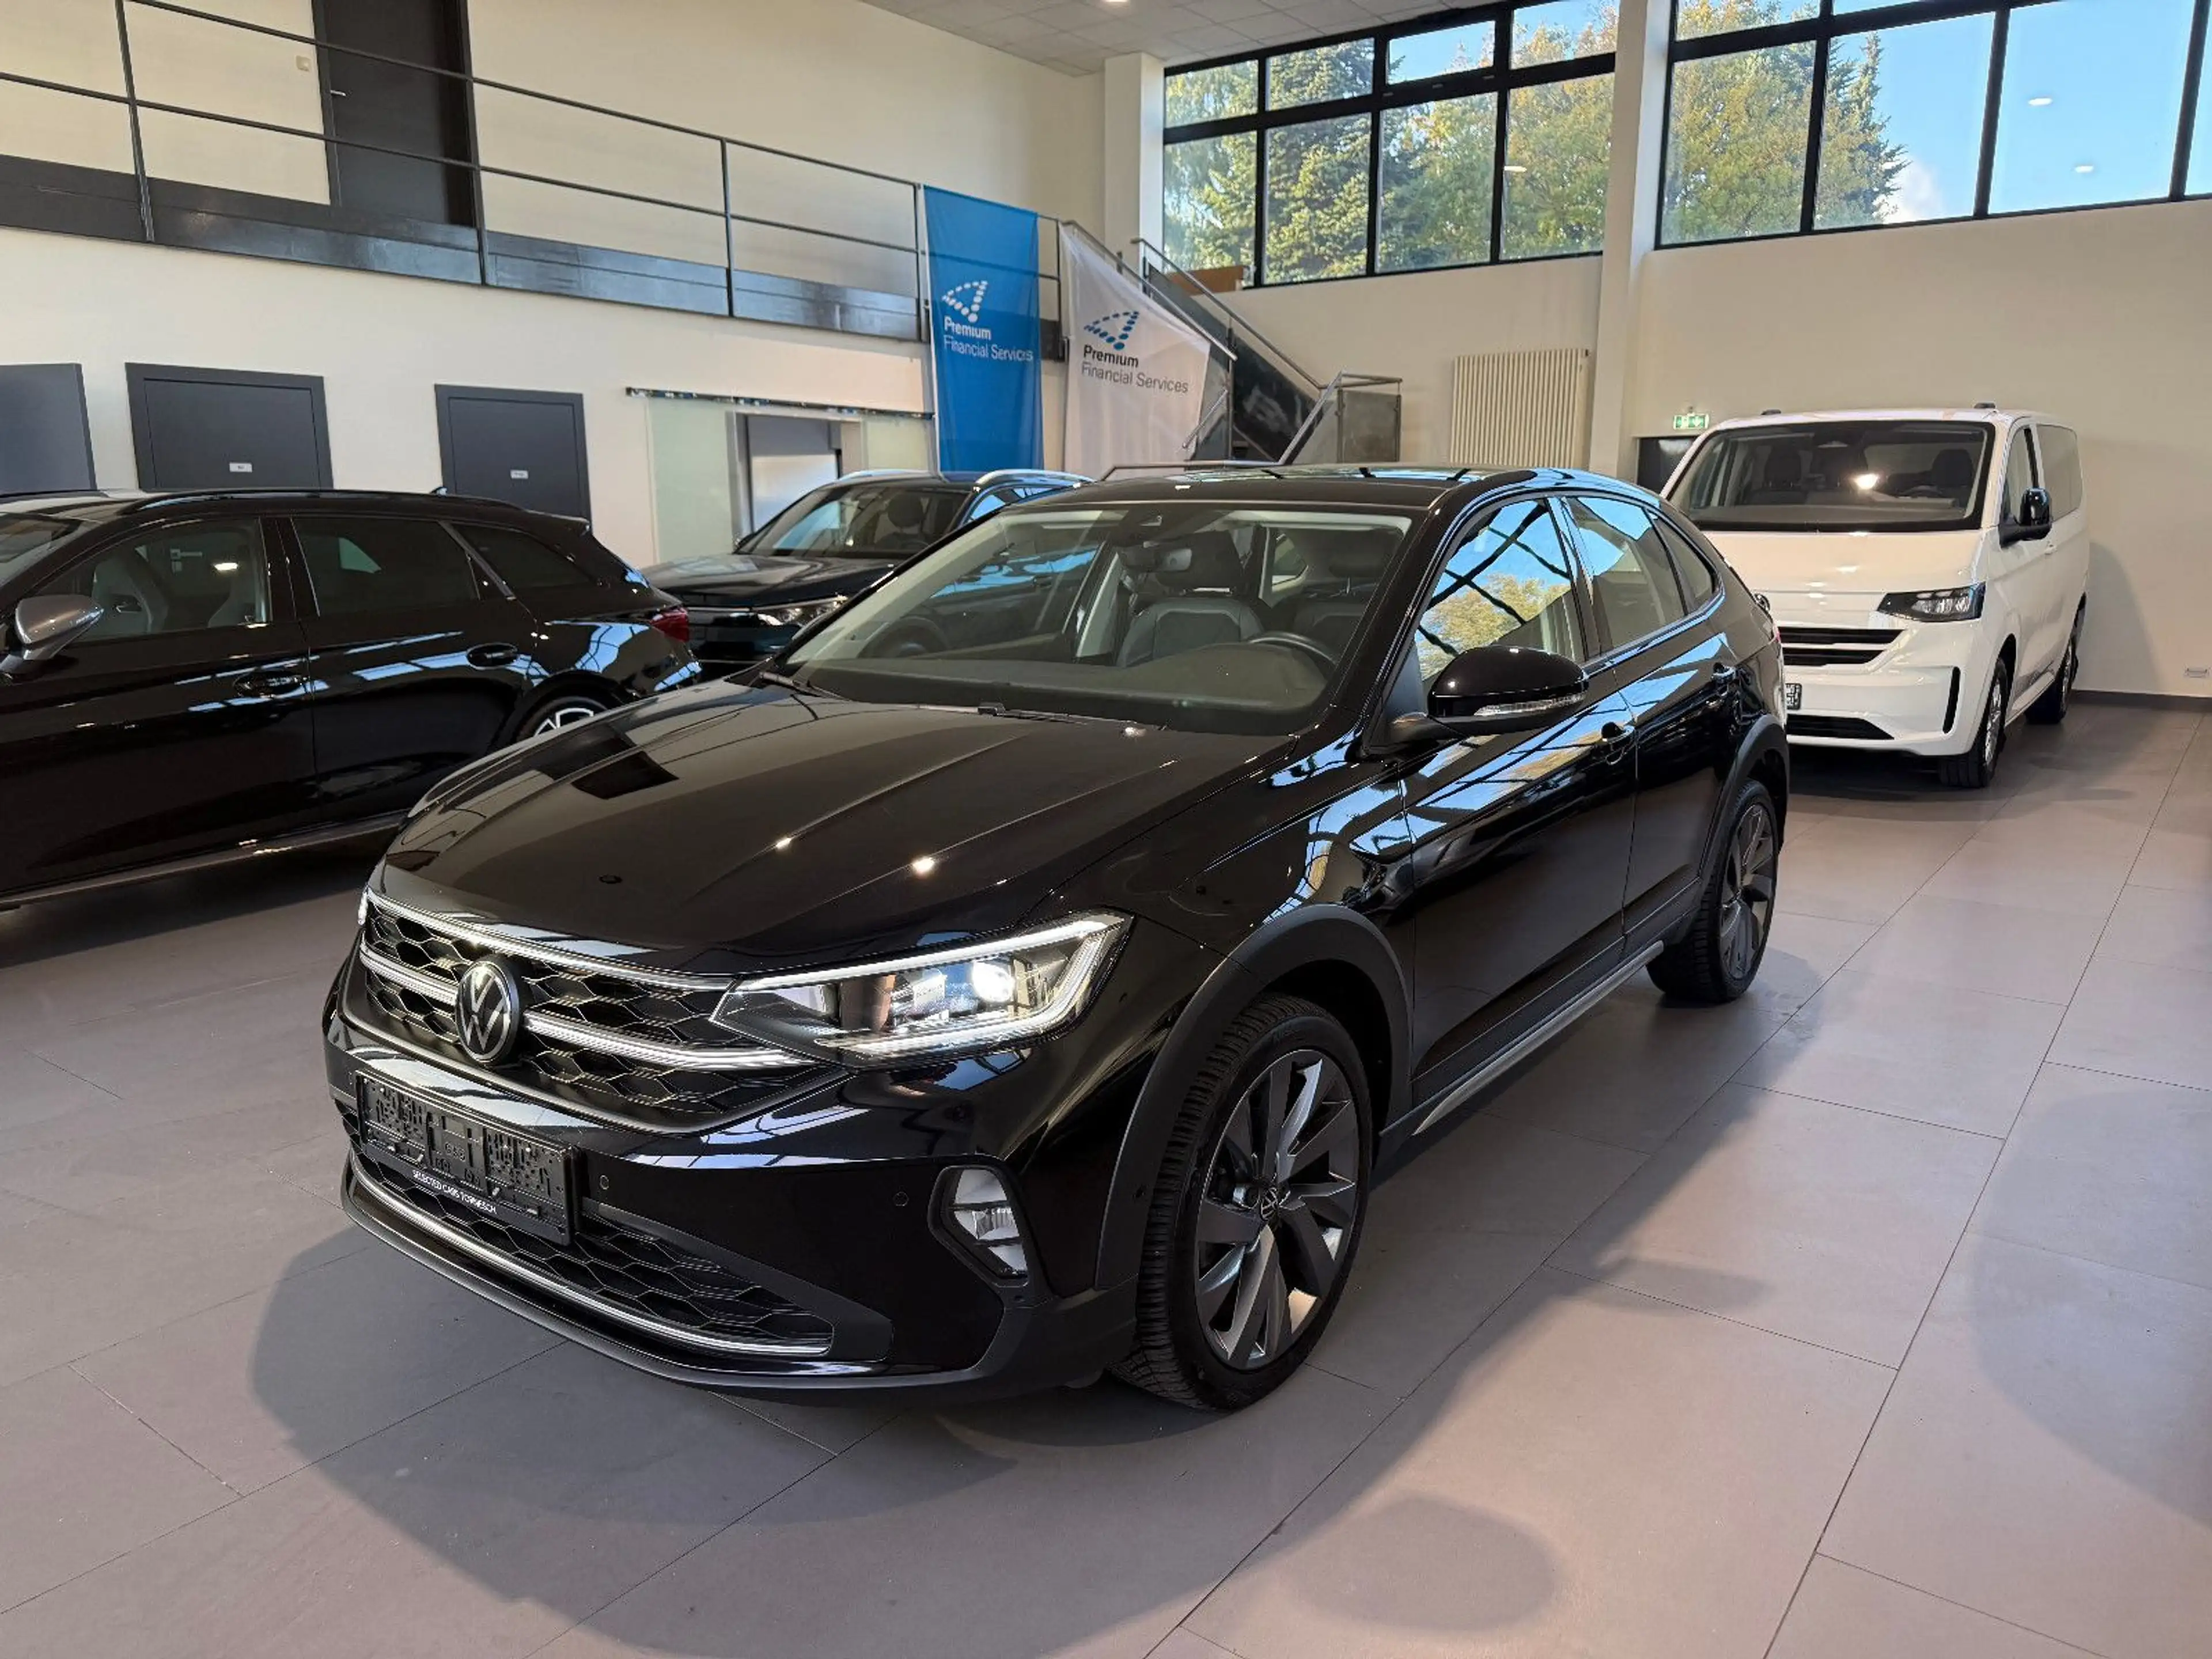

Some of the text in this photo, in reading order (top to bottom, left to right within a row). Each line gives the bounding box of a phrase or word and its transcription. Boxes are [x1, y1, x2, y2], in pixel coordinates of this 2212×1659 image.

[944, 315, 991, 340] Premium
[944, 334, 1034, 362] Financial Services
[1083, 344, 1139, 368] Premium
[1081, 361, 1190, 393] Financial Services
